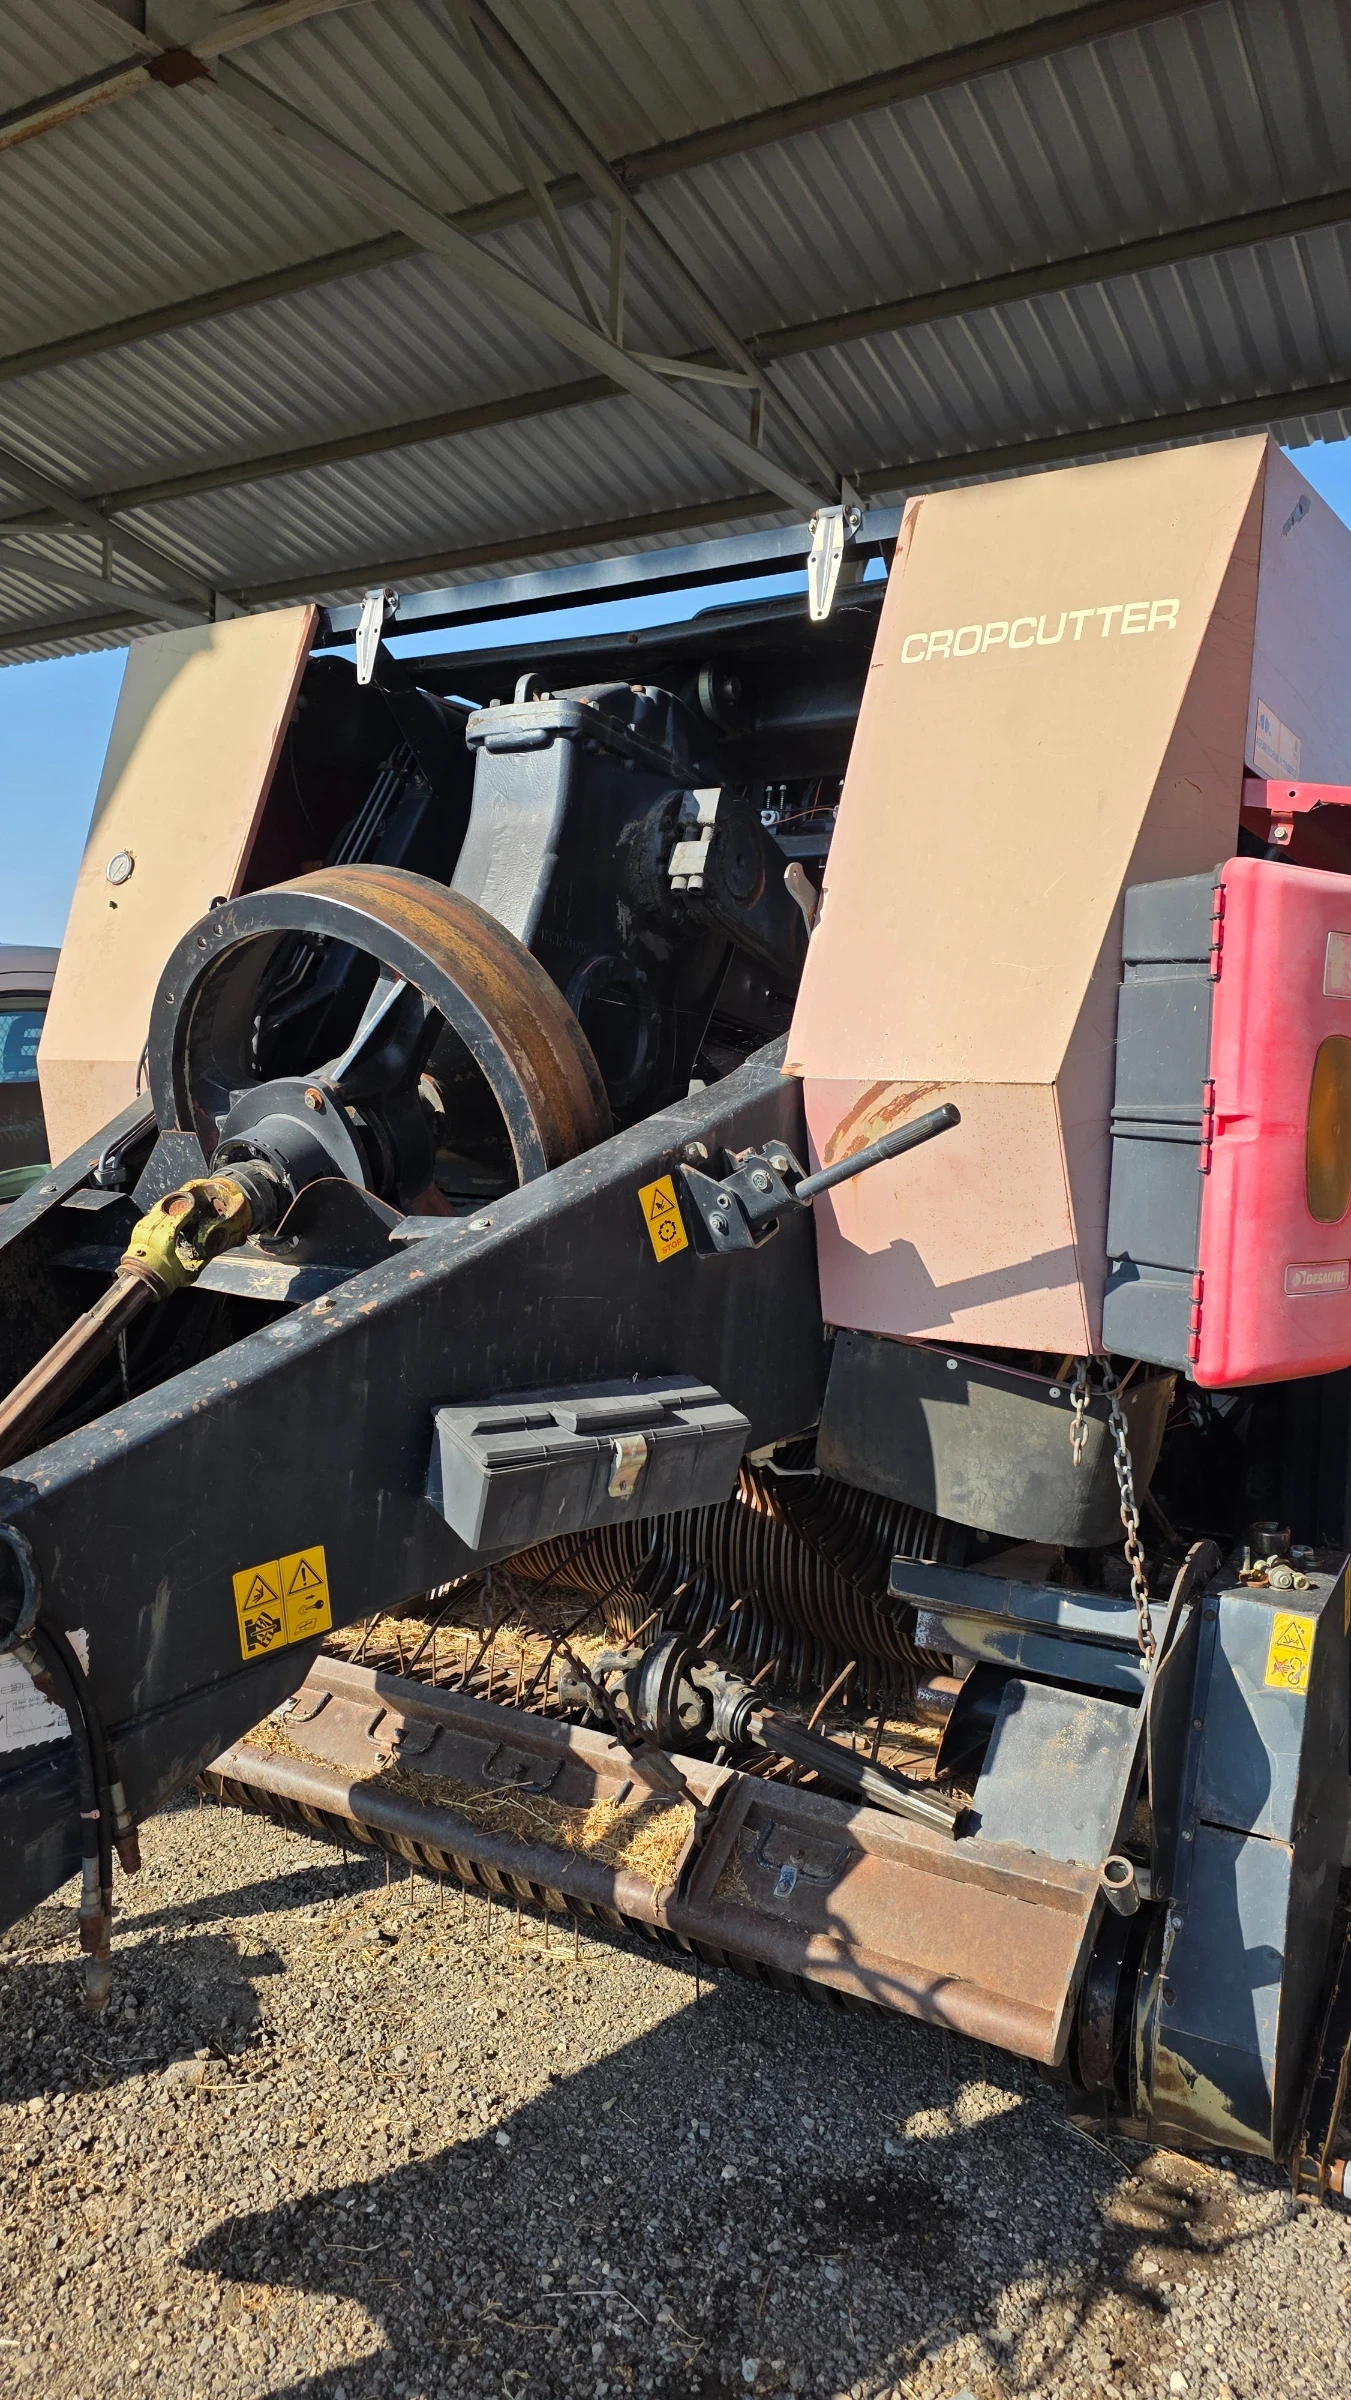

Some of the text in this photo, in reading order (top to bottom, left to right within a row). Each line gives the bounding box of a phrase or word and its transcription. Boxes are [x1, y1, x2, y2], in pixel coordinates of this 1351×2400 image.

[901, 598, 1180, 664] CROPCUTTER
[662, 1238, 682, 1254] STOP
[1306, 1270, 1345, 1285] DESAUTEL
